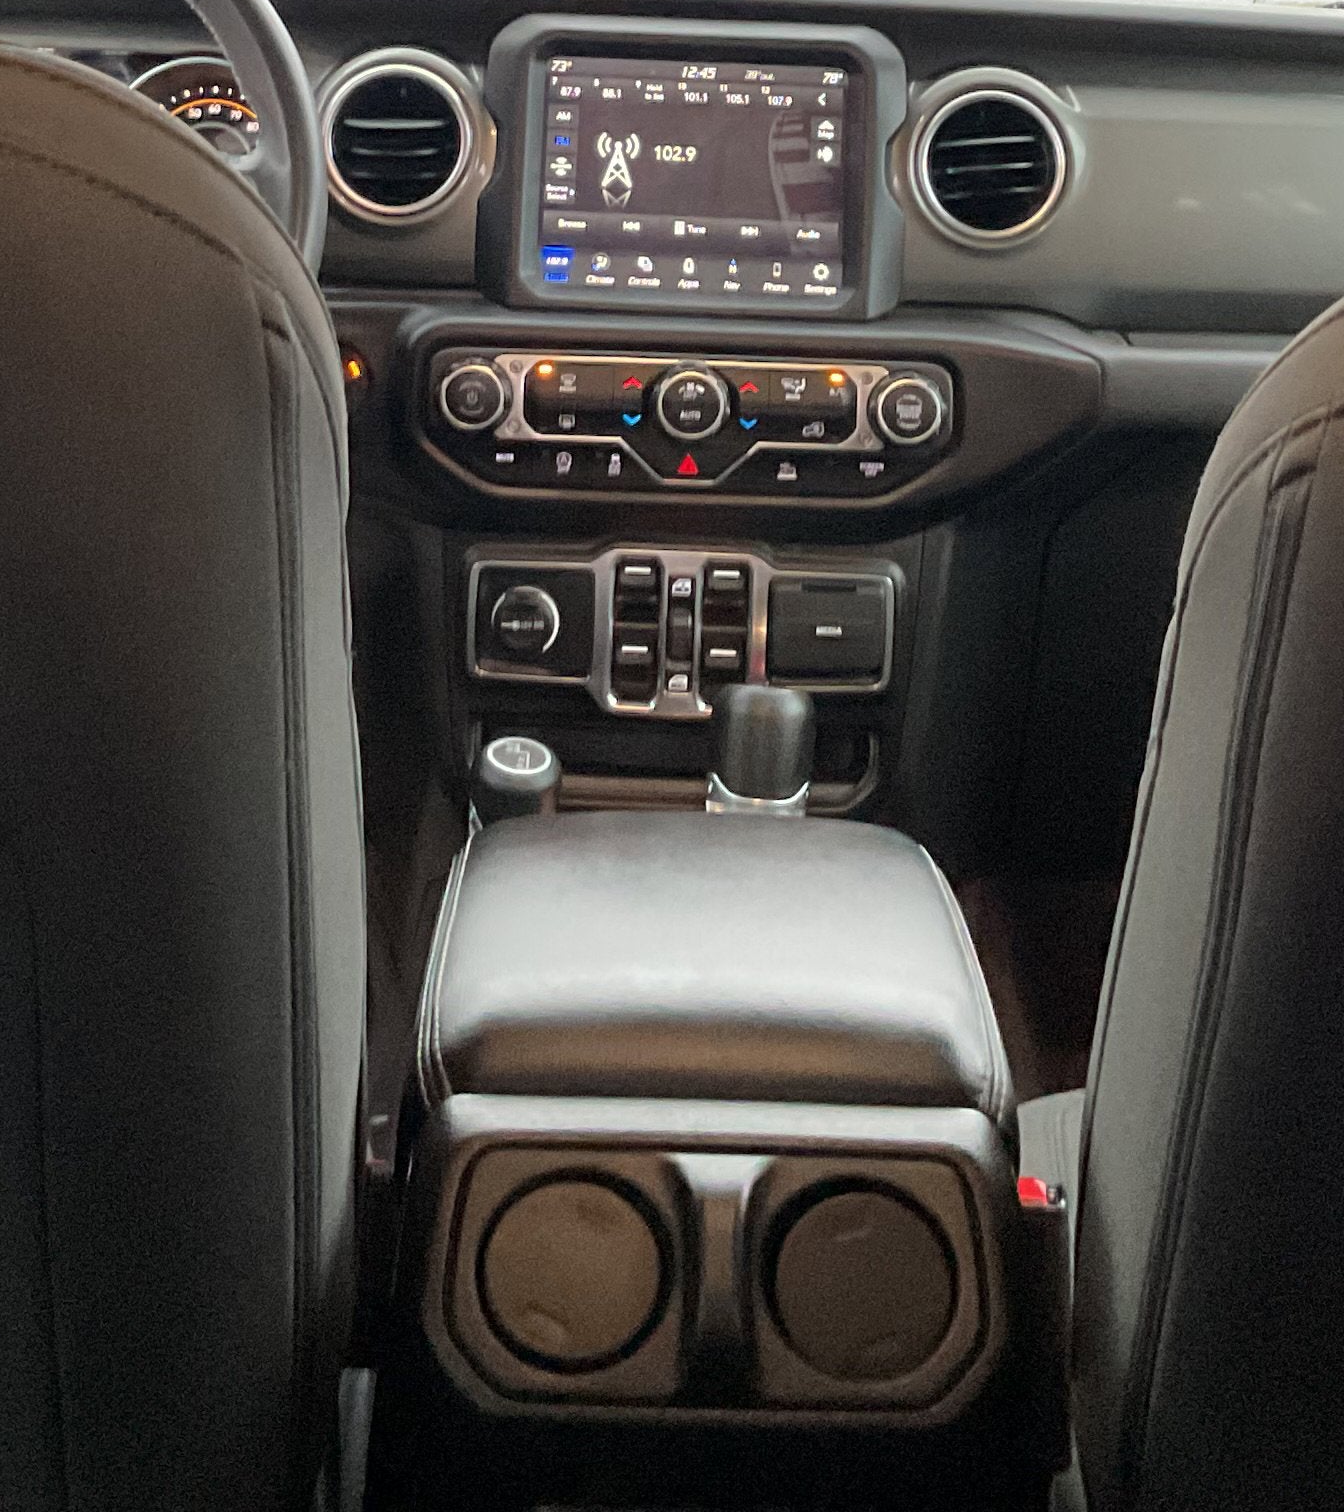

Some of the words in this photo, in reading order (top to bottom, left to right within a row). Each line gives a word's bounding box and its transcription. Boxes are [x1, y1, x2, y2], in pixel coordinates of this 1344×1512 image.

[682, 66, 717, 79] 12:45
[684, 92, 708, 103] 101.1
[726, 94, 750, 105] 105.1
[767, 95, 793, 106] 107.9
[556, 111, 571, 121] AM
[654, 145, 697, 162] 102.9
[687, 223, 707, 234] Tune
